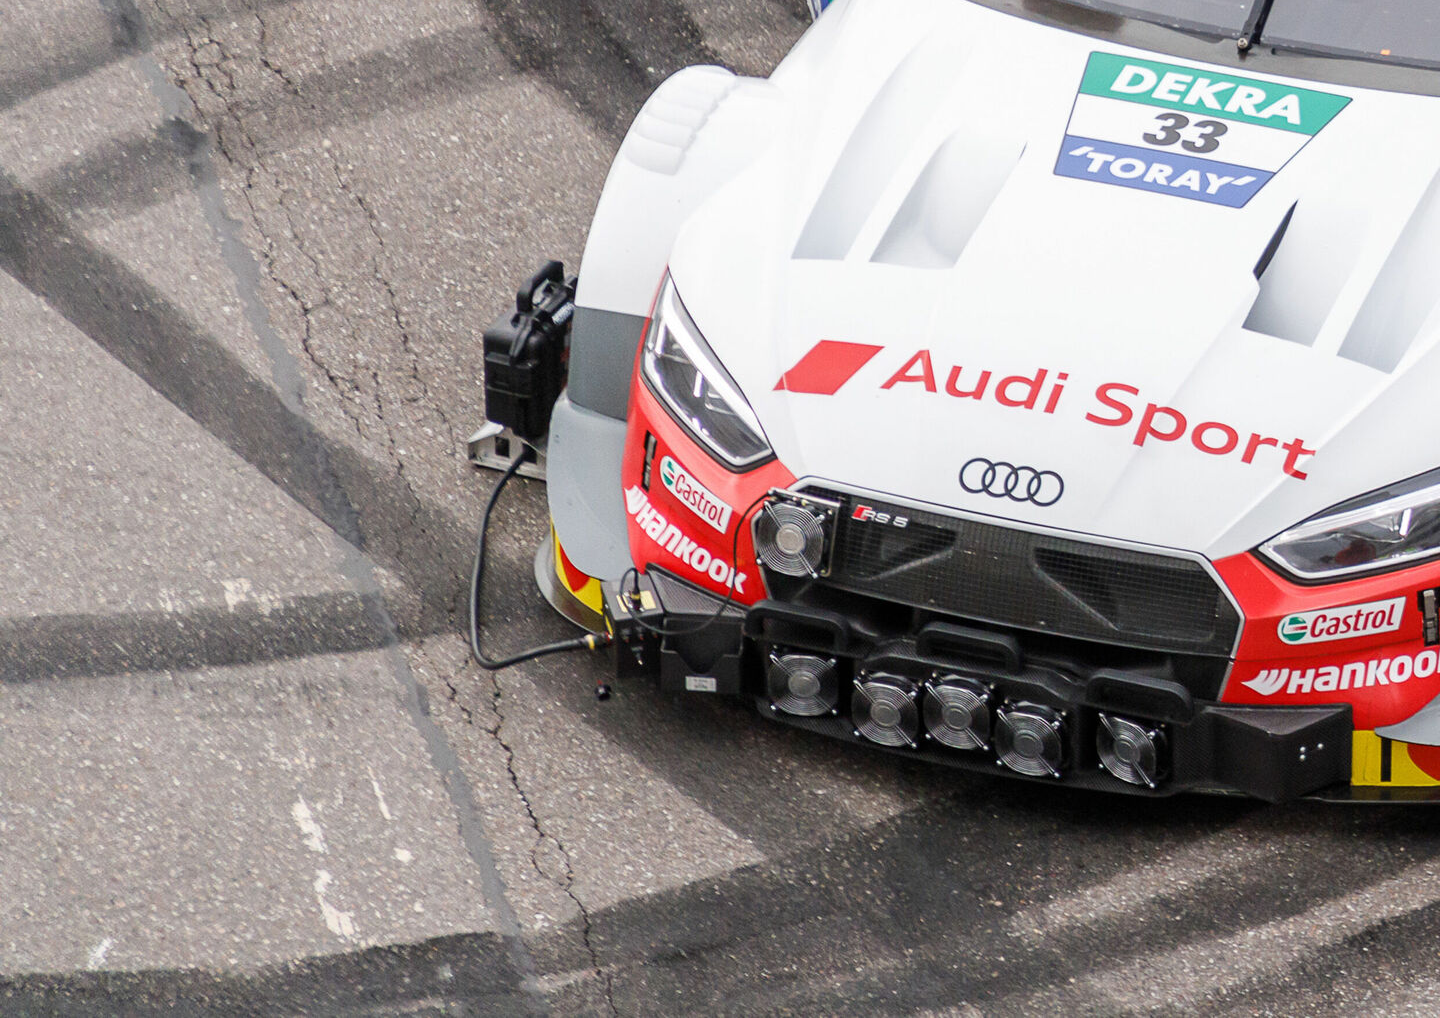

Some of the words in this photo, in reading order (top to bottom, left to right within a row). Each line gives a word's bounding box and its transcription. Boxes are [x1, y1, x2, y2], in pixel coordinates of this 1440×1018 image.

[1110, 64, 1301, 125] DEKRA
[1142, 112, 1228, 153] 33
[880, 349, 1069, 414] Audi
[1084, 381, 1316, 481] Sport
[674, 472, 725, 529] Castrol
[855, 507, 891, 523] RS
[893, 515, 909, 528] 5
[1310, 604, 1395, 638] Castrol
